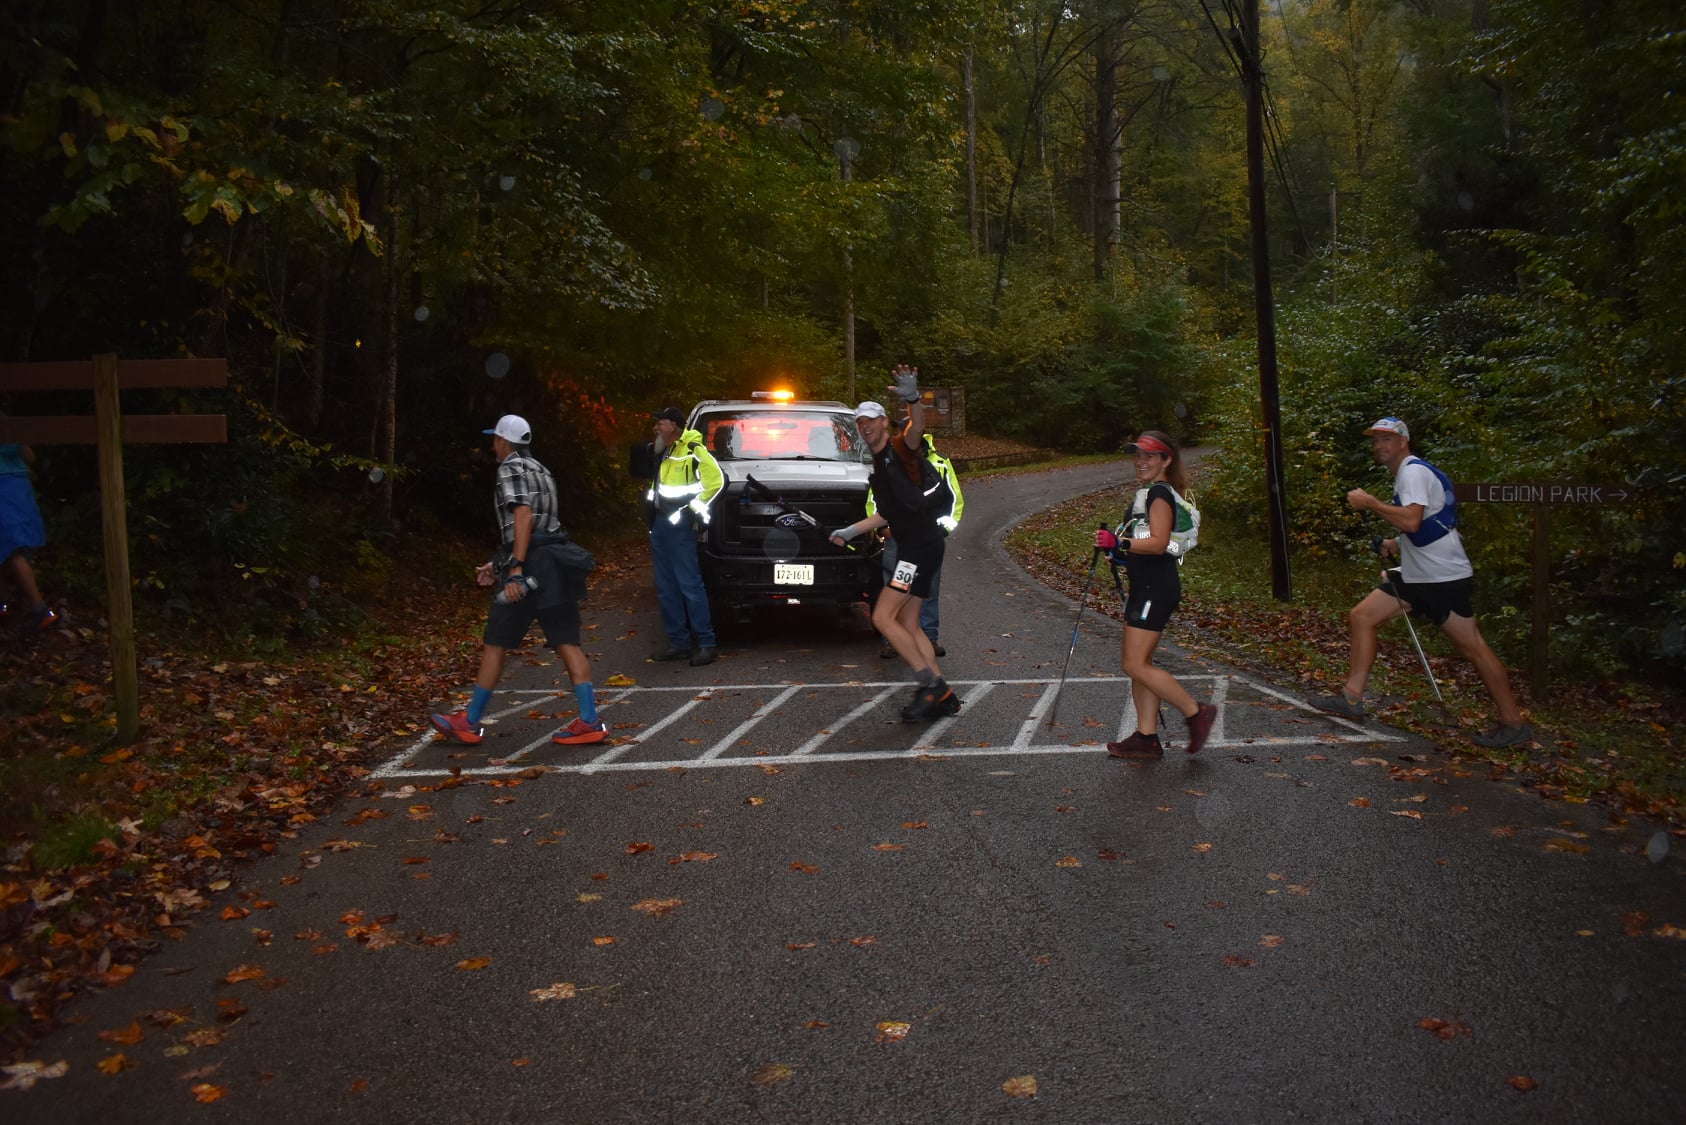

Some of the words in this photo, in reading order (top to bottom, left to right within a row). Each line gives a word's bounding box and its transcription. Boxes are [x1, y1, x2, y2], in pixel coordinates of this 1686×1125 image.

[1477, 485, 1543, 502] LEGION
[1550, 486, 1602, 503] PARK
[896, 570, 912, 583] 30
